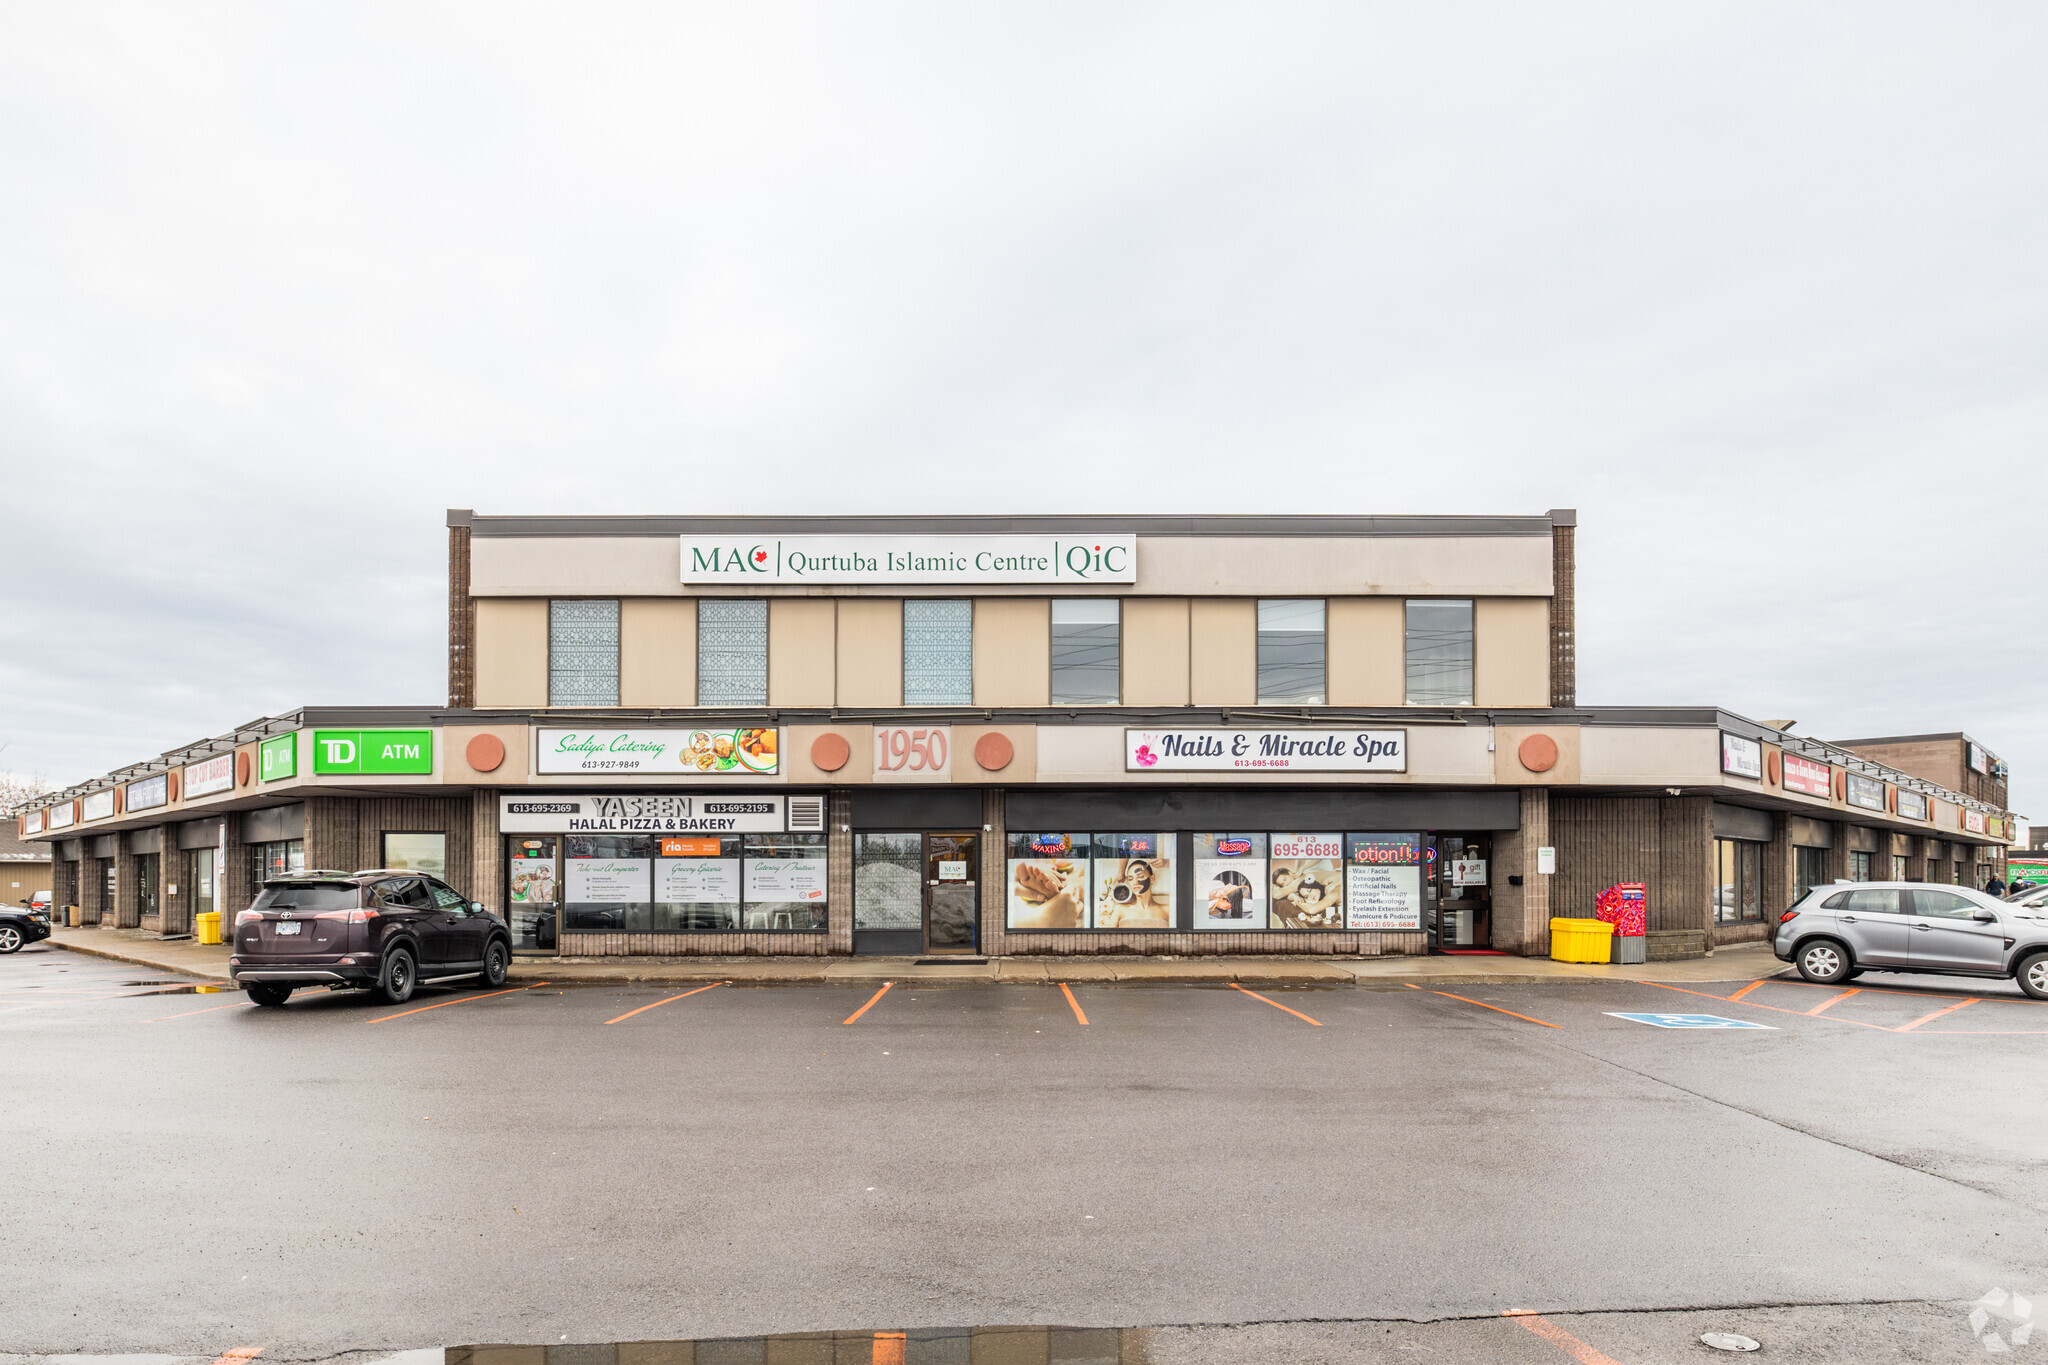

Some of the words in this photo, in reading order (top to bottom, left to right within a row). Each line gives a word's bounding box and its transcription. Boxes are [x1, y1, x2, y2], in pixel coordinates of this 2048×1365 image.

[690, 543, 769, 573] MAC
[787, 550, 878, 576] Qurtuba
[887, 550, 967, 572] Islamic
[975, 550, 1049, 573] Centre
[1065, 545, 1128, 579] QiC
[320, 739, 356, 764] TD
[381, 744, 419, 759] ATM
[554, 734, 606, 759] Sadiya
[608, 734, 668, 759] Catering
[878, 729, 947, 772] 1950
[1161, 733, 1225, 757] Nails
[1231, 733, 1251, 757] &
[1258, 733, 1347, 757] Miracle
[1352, 733, 1400, 763] Spa
[263, 748, 273, 772] TD
[279, 748, 291, 764] ATM
[581, 760, 640, 770] 613-927-9849
[1234, 759, 1289, 767] 613-695-6688
[187, 763, 198, 787] TOP
[199, 761, 208, 784] CUT
[209, 756, 230, 781] BARBER
[513, 803, 572, 814] 613-695-2369
[590, 797, 693, 818] YASEEN
[709, 803, 768, 814] 613-695-2195
[569, 818, 617, 831] HALAL
[620, 818, 662, 831] PIZZA
[665, 818, 676, 831] &
[679, 818, 736, 831] BAKERY
[665, 841, 682, 851] ria
[1032, 842, 1066, 854] WAXING
[1219, 840, 1249, 853] Massage
[1274, 843, 1340, 857] 695-6688
[671, 863, 697, 875] Grocery
[754, 862, 781, 874] Catering
[1470, 864, 1480, 872] gift
